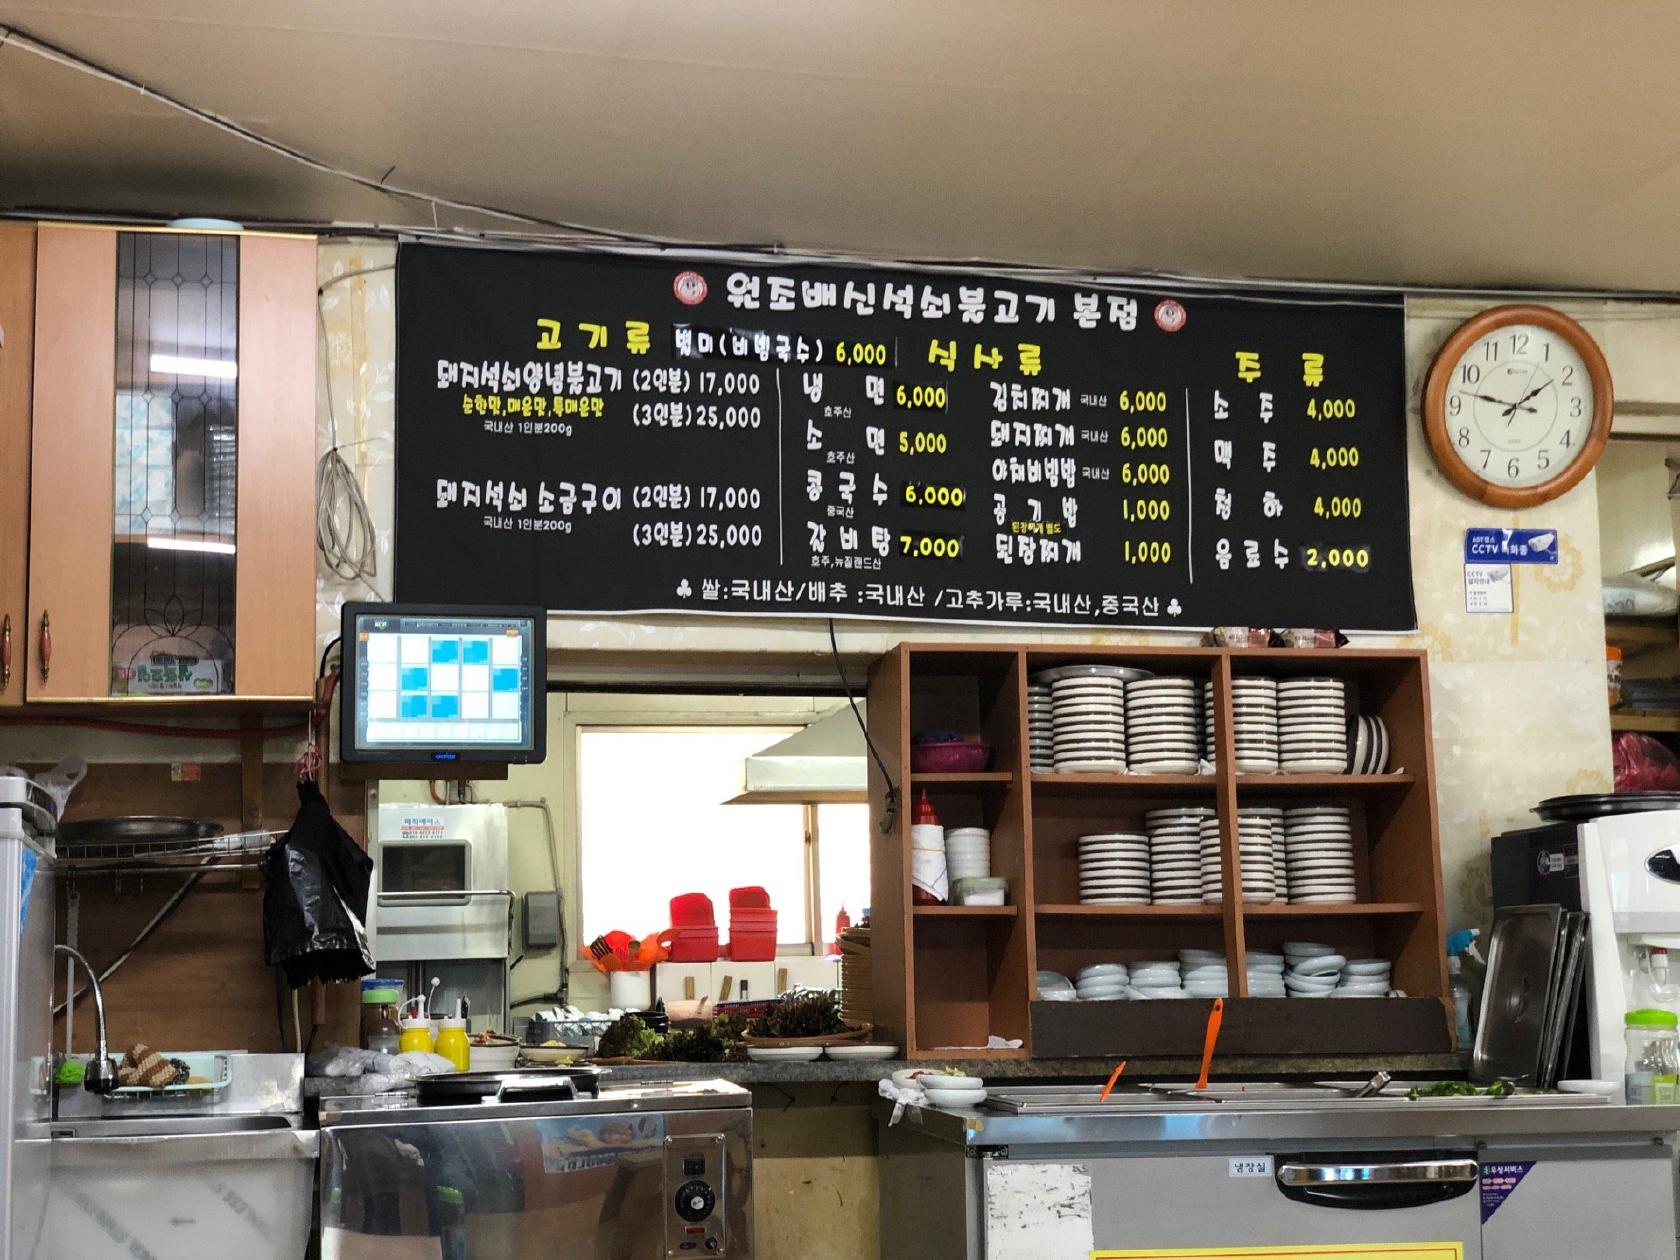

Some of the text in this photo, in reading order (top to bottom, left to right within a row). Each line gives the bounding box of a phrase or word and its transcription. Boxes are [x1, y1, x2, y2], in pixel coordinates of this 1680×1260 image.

[727, 271, 1056, 324] 원조배신석쇠불고기
[1073, 292, 1138, 331] 본점
[836, 342, 886, 365] 6,000
[1483, 340, 1498, 362] 11
[1509, 333, 1529, 355] 12
[1543, 342, 1550, 362] 1
[438, 360, 759, 396] 돼지석쇠양념불고기 (2인분) 17,000
[1461, 363, 1480, 385] 10
[1561, 364, 1573, 386] 2
[897, 386, 947, 408] 6,000
[990, 382, 1166, 413] 김치찌개 국내산 6,000
[1449, 394, 1462, 417] 9
[1569, 395, 1582, 418] 3
[633, 402, 760, 430] (3인분) 25,000
[1307, 399, 1355, 421] 4,000
[484, 421, 572, 436] 국내산 1인분200g
[991, 420, 1167, 449] 돼지찌개 국내산 6,000
[1457, 425, 1470, 449] 8
[1559, 428, 1571, 449] 4
[900, 432, 946, 455] 5,000
[1310, 447, 1358, 469] 4,000
[1479, 449, 1491, 470] 7
[1506, 456, 1520, 480] 6
[1536, 449, 1550, 470] 5
[992, 457, 1169, 488] 야채비빔밥 국내산 6,000
[437, 479, 760, 514] 돼지석쇠 소금구이 (2인분) 17,000
[906, 486, 963, 506] 6,000
[1124, 500, 1169, 522] 1,000
[1314, 497, 1361, 519] 4,000
[484, 516, 571, 533] 국내산 1인분200g
[633, 521, 761, 548] (3인분) 25,000
[900, 536, 959, 557] 7,000
[996, 532, 1170, 565] 된장찌개 1,000
[1471, 544, 1498, 554] CCTV
[1307, 549, 1368, 569] 2,000
[1234, 1162, 1266, 1173] 냉장실
